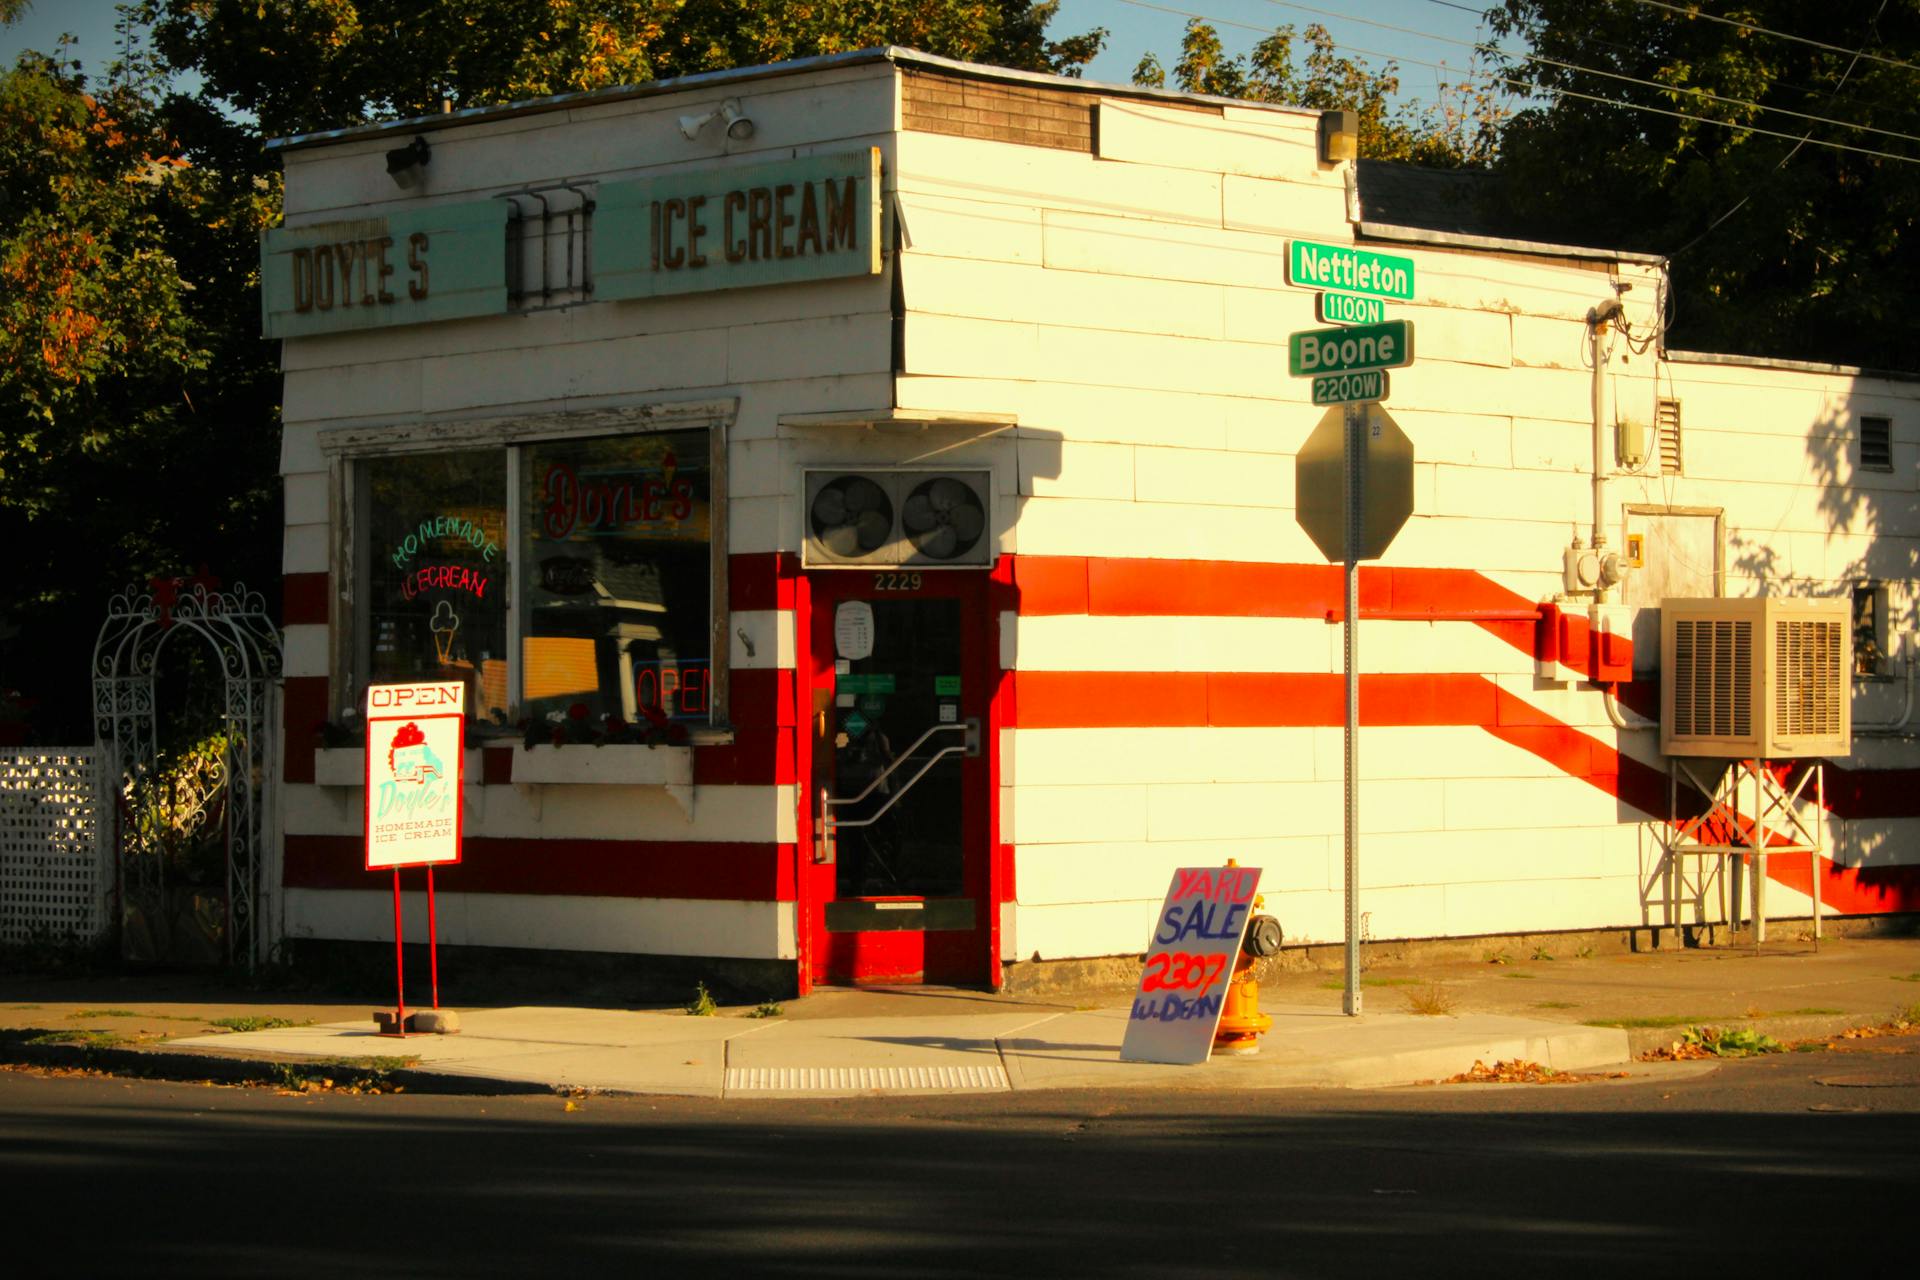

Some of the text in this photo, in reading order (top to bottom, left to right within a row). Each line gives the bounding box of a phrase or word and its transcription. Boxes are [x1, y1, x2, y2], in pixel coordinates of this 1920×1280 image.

[650, 176, 858, 272] ICE CREAM
[1300, 246, 1407, 294] Nettleton
[1329, 295, 1379, 323] 1100N
[1299, 335, 1395, 369] Boone
[1316, 374, 1377, 402] 2200W
[391, 515, 499, 569] HOMEMADE
[874, 573, 922, 591] 2229
[372, 686, 460, 707] OPEN
[375, 818, 452, 833] HOMEMADE
[375, 829, 452, 843] ICE CREAM
[1172, 869, 1255, 904] YARD
[1156, 900, 1247, 945] SALE
